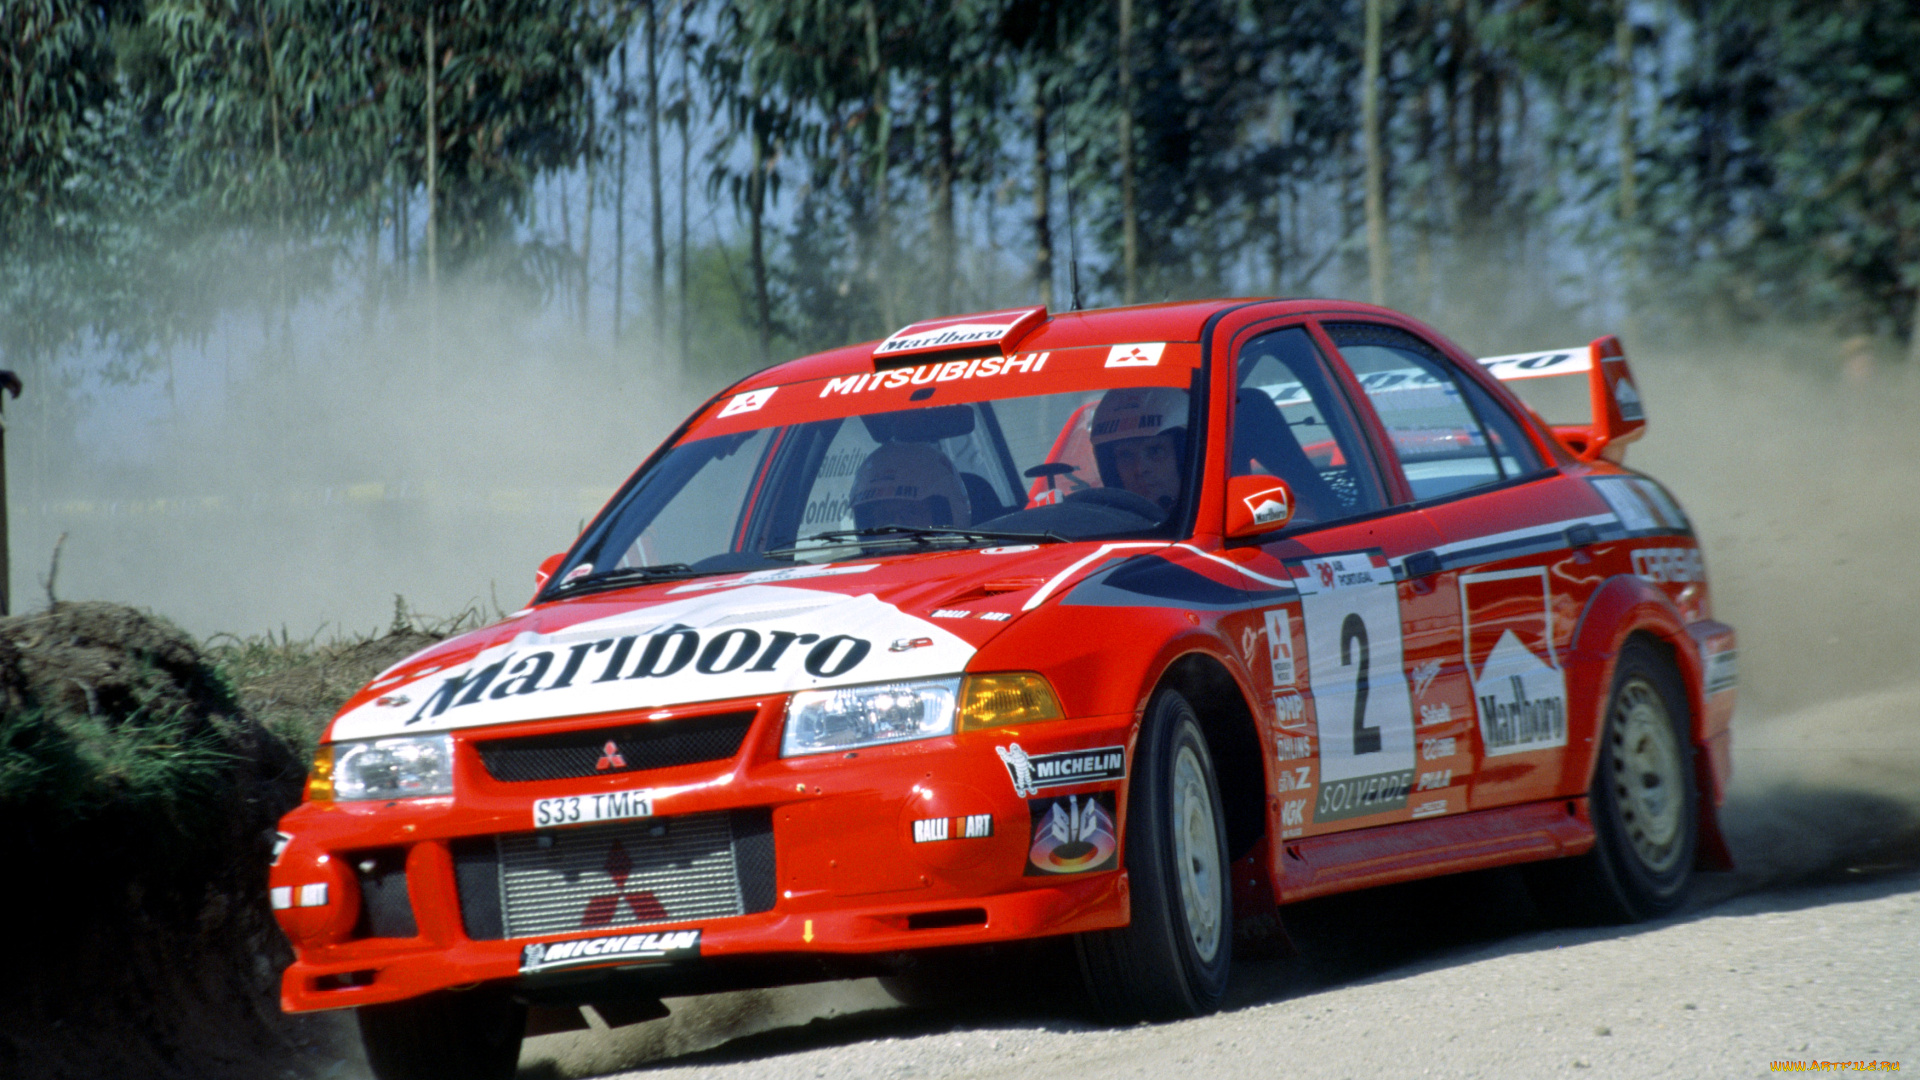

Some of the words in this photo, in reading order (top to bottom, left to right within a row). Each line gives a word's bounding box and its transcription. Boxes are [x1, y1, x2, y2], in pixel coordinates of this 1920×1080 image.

[881, 327, 1003, 352] Marlboro
[819, 352, 1050, 398] MITSUBISHI
[1338, 571, 1374, 586] PORTUGAL
[980, 611, 1010, 621] ART
[404, 622, 872, 726] Marlboro
[1341, 612, 1383, 756] 2
[1479, 674, 1564, 748] Marlboro
[1036, 752, 1122, 777] MICHELIN
[537, 796, 581, 825] S33
[592, 790, 648, 819] TMR
[1320, 773, 1412, 814] SOLVERDE
[914, 817, 949, 843] RALLI
[965, 814, 991, 837] ART
[543, 929, 700, 962] MICHELIN
